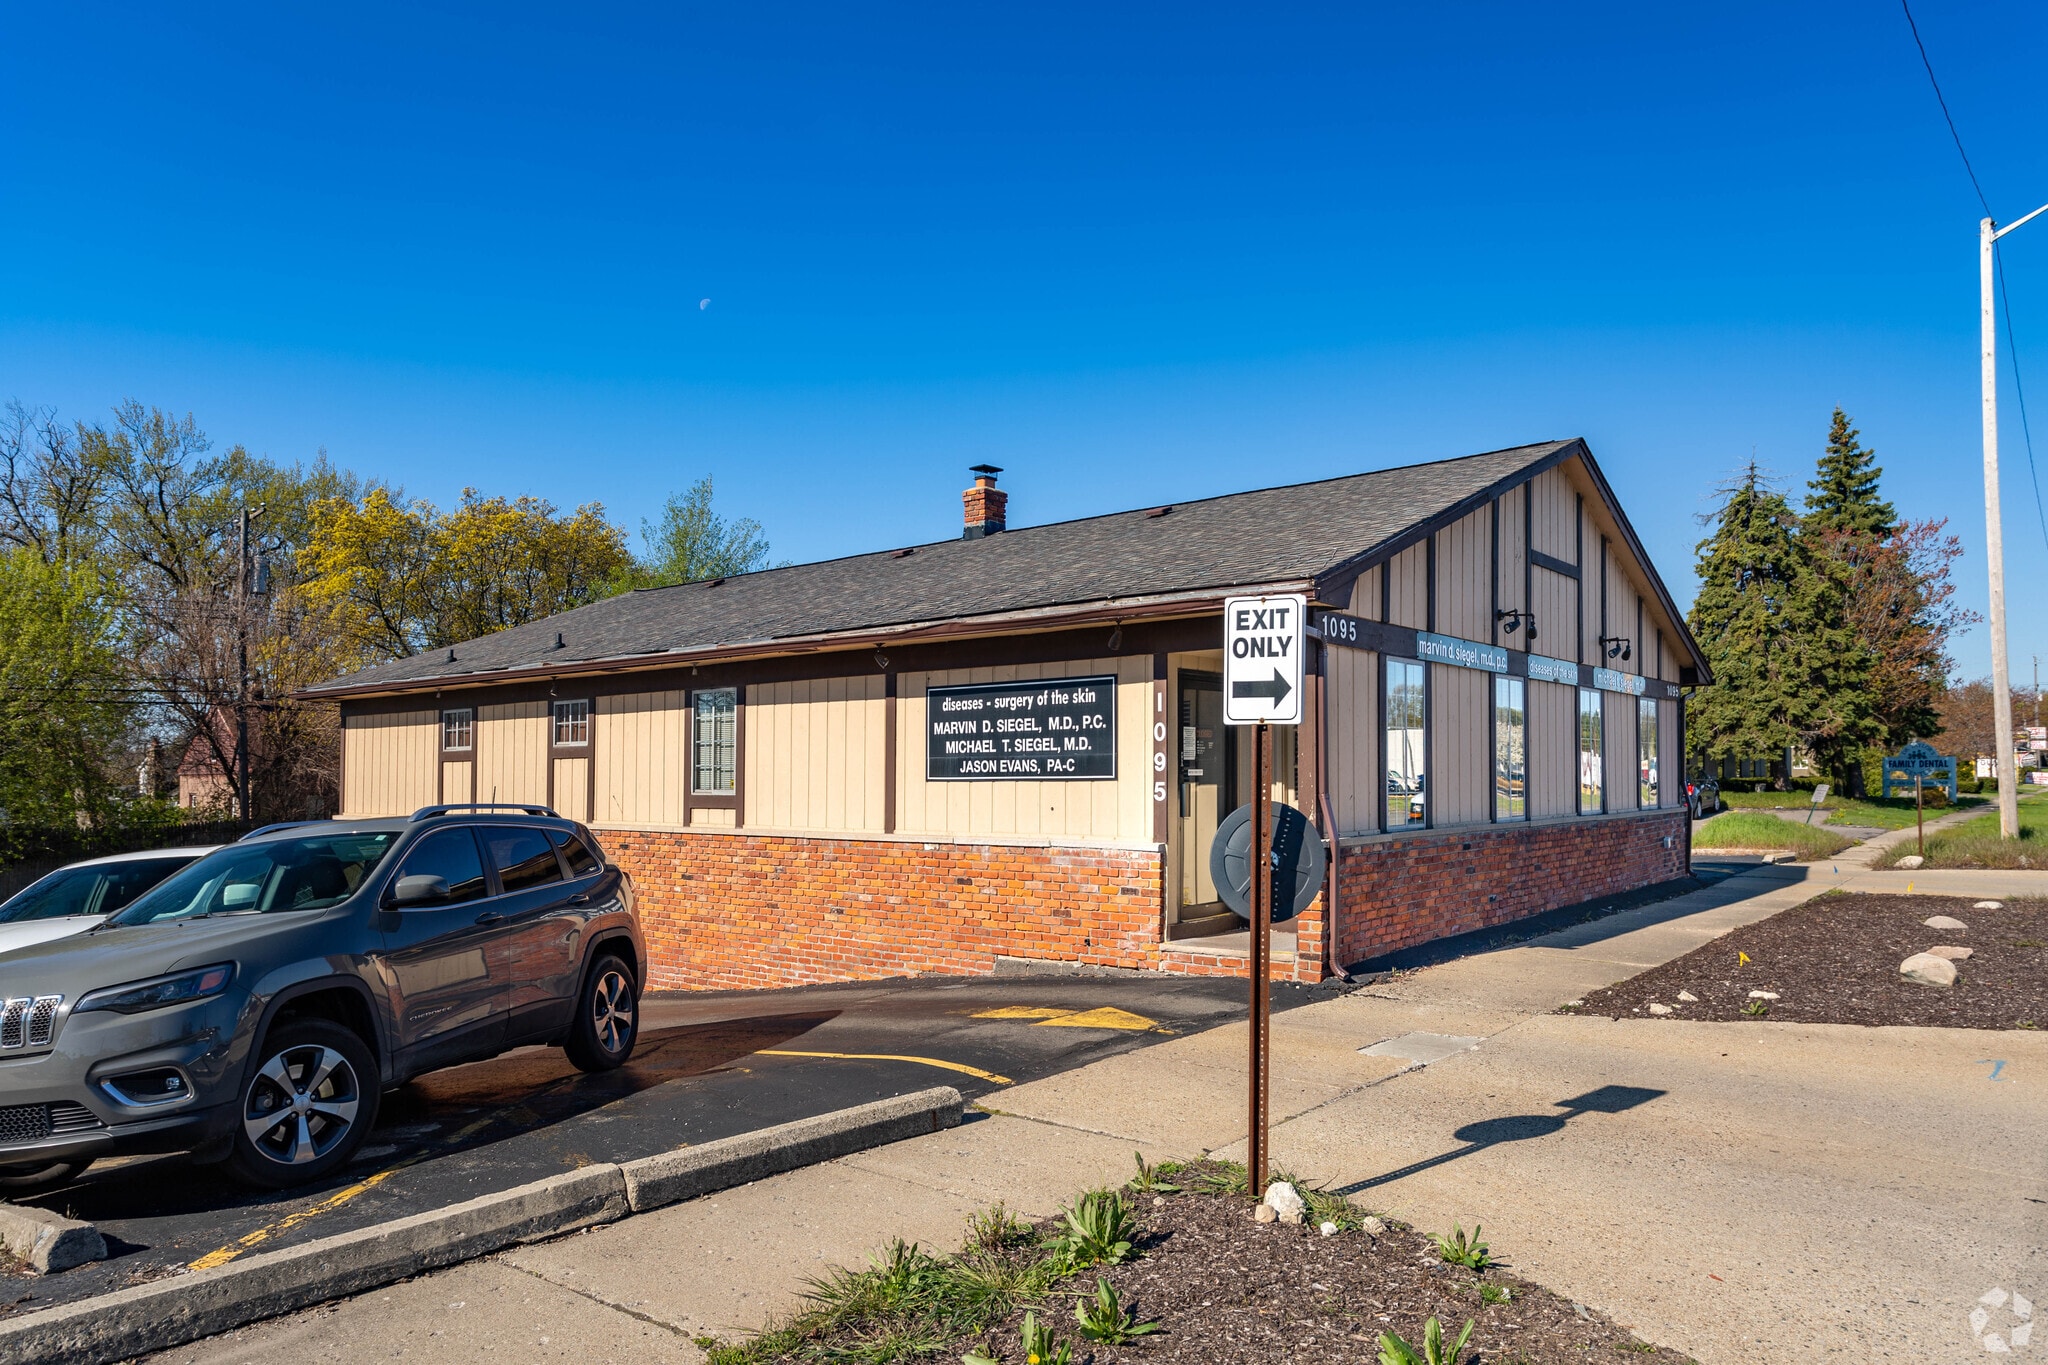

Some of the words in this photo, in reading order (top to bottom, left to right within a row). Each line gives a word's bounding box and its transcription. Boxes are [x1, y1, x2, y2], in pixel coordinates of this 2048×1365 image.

[1236, 608, 1290, 631] EXIT
[1322, 615, 1357, 642] 1095
[1232, 635, 1293, 659] ONLY
[1419, 640, 1447, 657] marvin
[1448, 643, 1455, 659] d.
[1455, 644, 1479, 667] siegel,
[1530, 660, 1552, 676] diseases
[1553, 664, 1559, 677] of
[942, 697, 983, 712] diseases
[994, 695, 1034, 711] surgery
[1037, 690, 1048, 706] of
[1051, 689, 1069, 705] the
[1072, 688, 1096, 704] skin
[934, 720, 976, 735] MARVIN
[982, 720, 994, 733] D.
[996, 718, 1042, 733] SIEGEL,
[1048, 716, 1079, 732] M.D.,
[1082, 715, 1107, 729] P.C.
[946, 740, 996, 754] MICHAEL
[1002, 739, 1011, 752] T.
[1014, 738, 1061, 754] SIEGEL,
[1064, 737, 1092, 751] M.D.
[960, 759, 997, 773] JASON
[1000, 759, 1041, 774] EVANS,
[1047, 758, 1075, 772] PA-C
[1888, 760, 1916, 768] FAMILY
[1919, 760, 1949, 768] DENTAL
[409, 1005, 452, 1021] CHEROKEE
